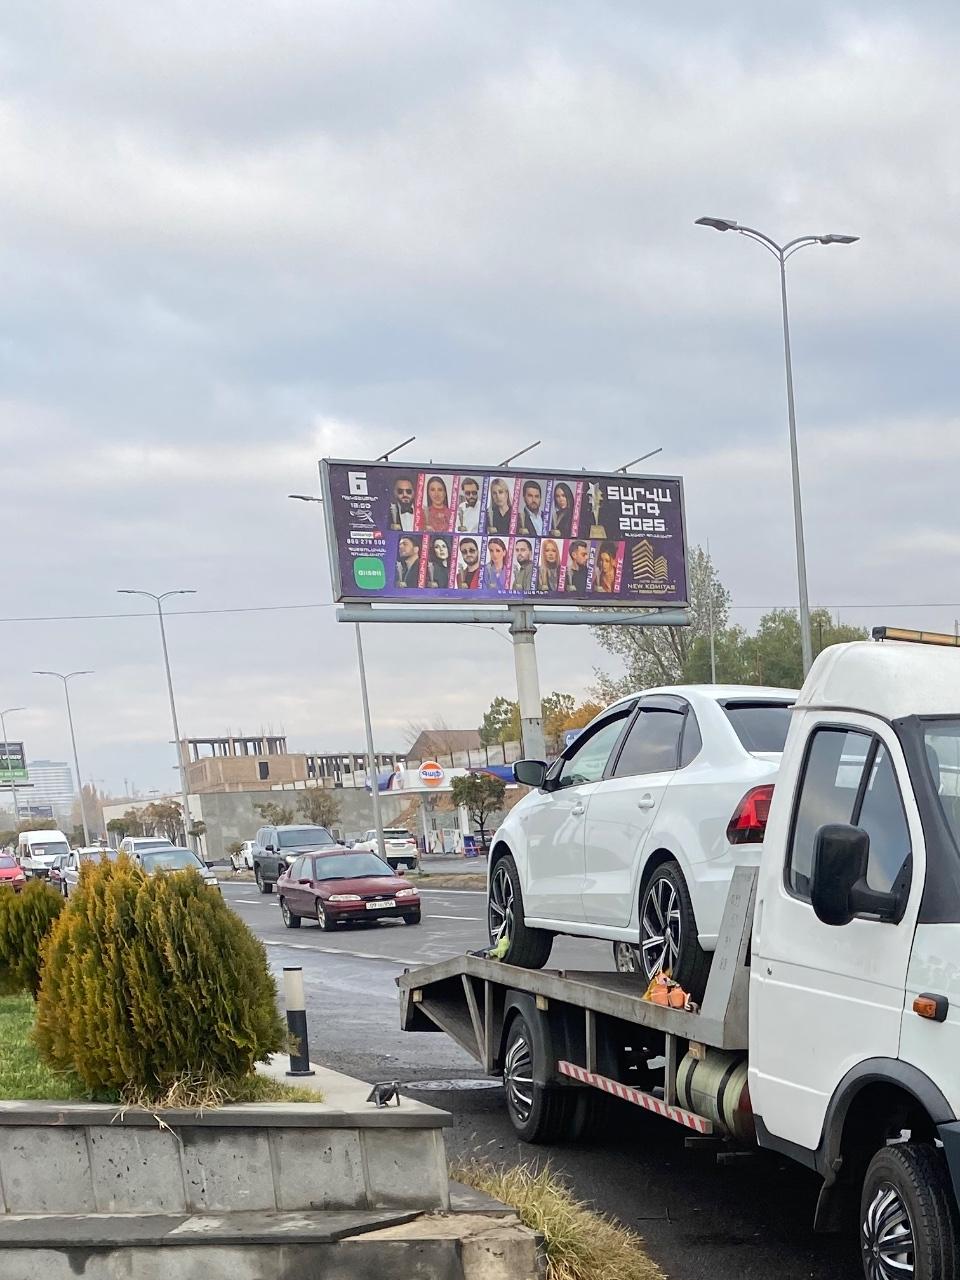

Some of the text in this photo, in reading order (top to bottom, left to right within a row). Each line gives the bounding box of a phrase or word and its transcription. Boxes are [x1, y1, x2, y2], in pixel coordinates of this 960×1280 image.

[347, 471, 369, 496] 6
[606, 486, 672, 502] ՏԱՐՎԱ
[621, 501, 660, 516] ԵՐԳ
[618, 517, 666, 531] 2025
